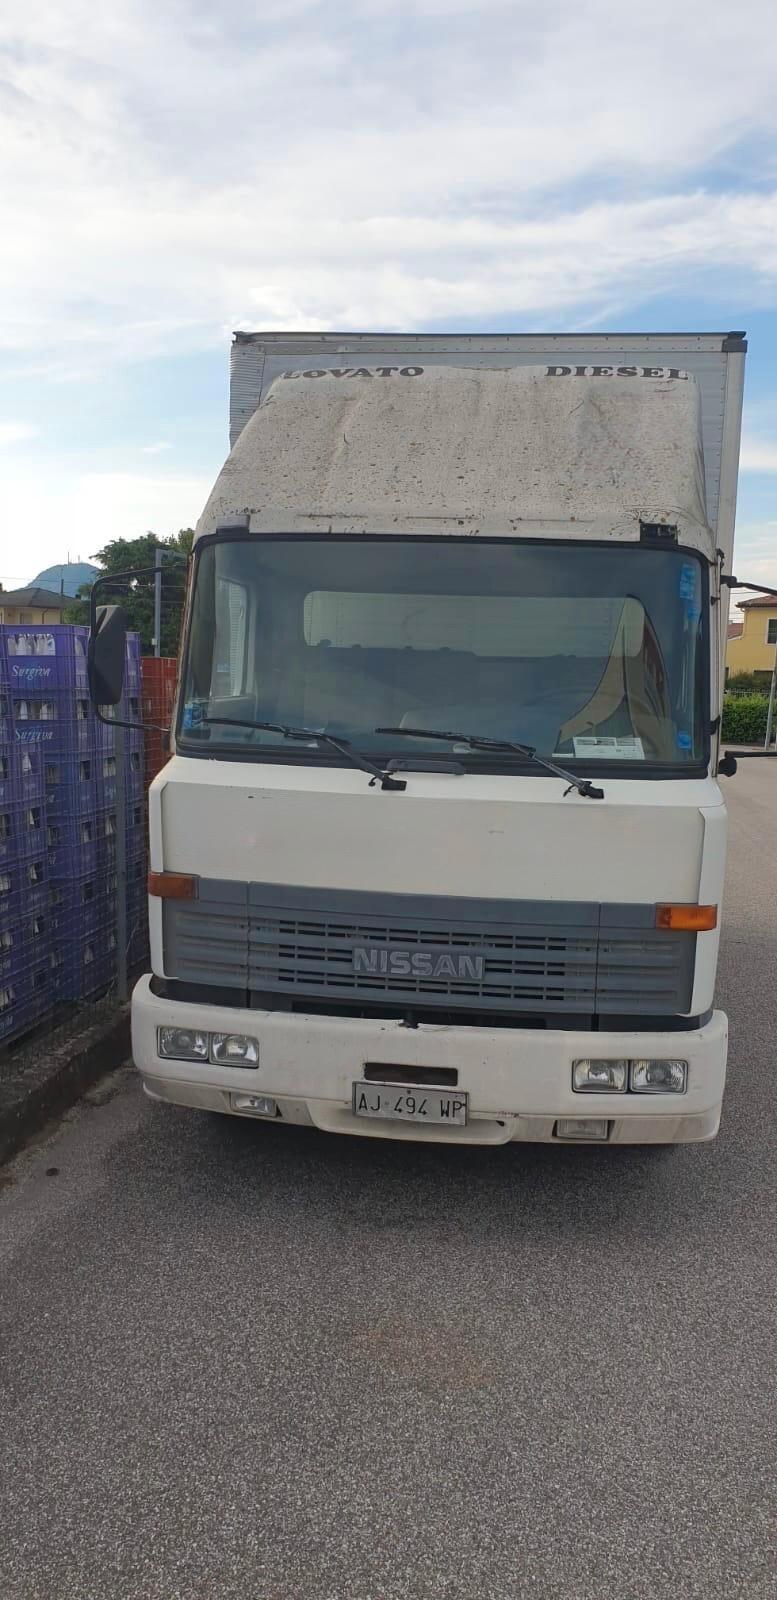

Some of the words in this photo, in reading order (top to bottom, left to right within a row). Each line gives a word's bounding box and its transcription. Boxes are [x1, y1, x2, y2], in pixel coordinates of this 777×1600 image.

[544, 366, 688, 380] DIESEL
[353, 947, 483, 979] NISSAN
[358, 1093, 381, 1111] AJ
[393, 1097, 428, 1115] 494
[440, 1100, 463, 1118] WP
